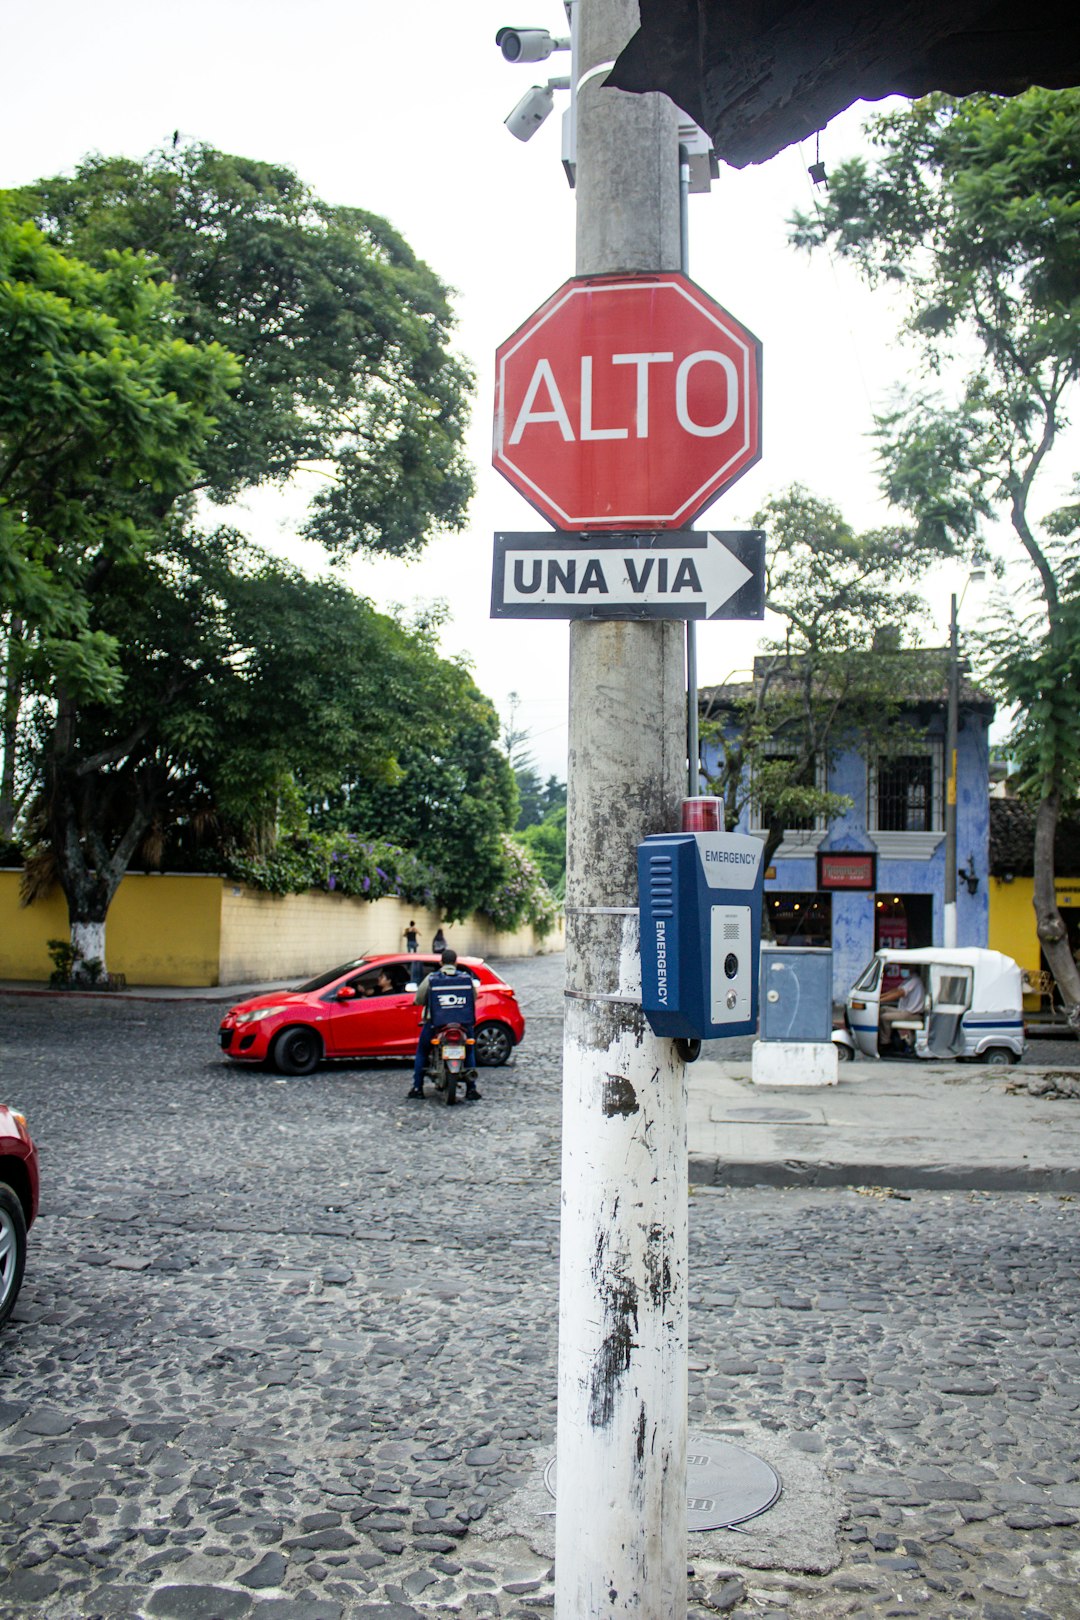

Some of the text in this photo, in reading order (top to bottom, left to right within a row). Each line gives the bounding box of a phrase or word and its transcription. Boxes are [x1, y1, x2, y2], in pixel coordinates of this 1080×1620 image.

[508, 350, 739, 445] ALTO
[513, 557, 703, 594] UNA VIA
[705, 850, 756, 865] EMERGENCY
[655, 920, 668, 1006] EMERGENCY
